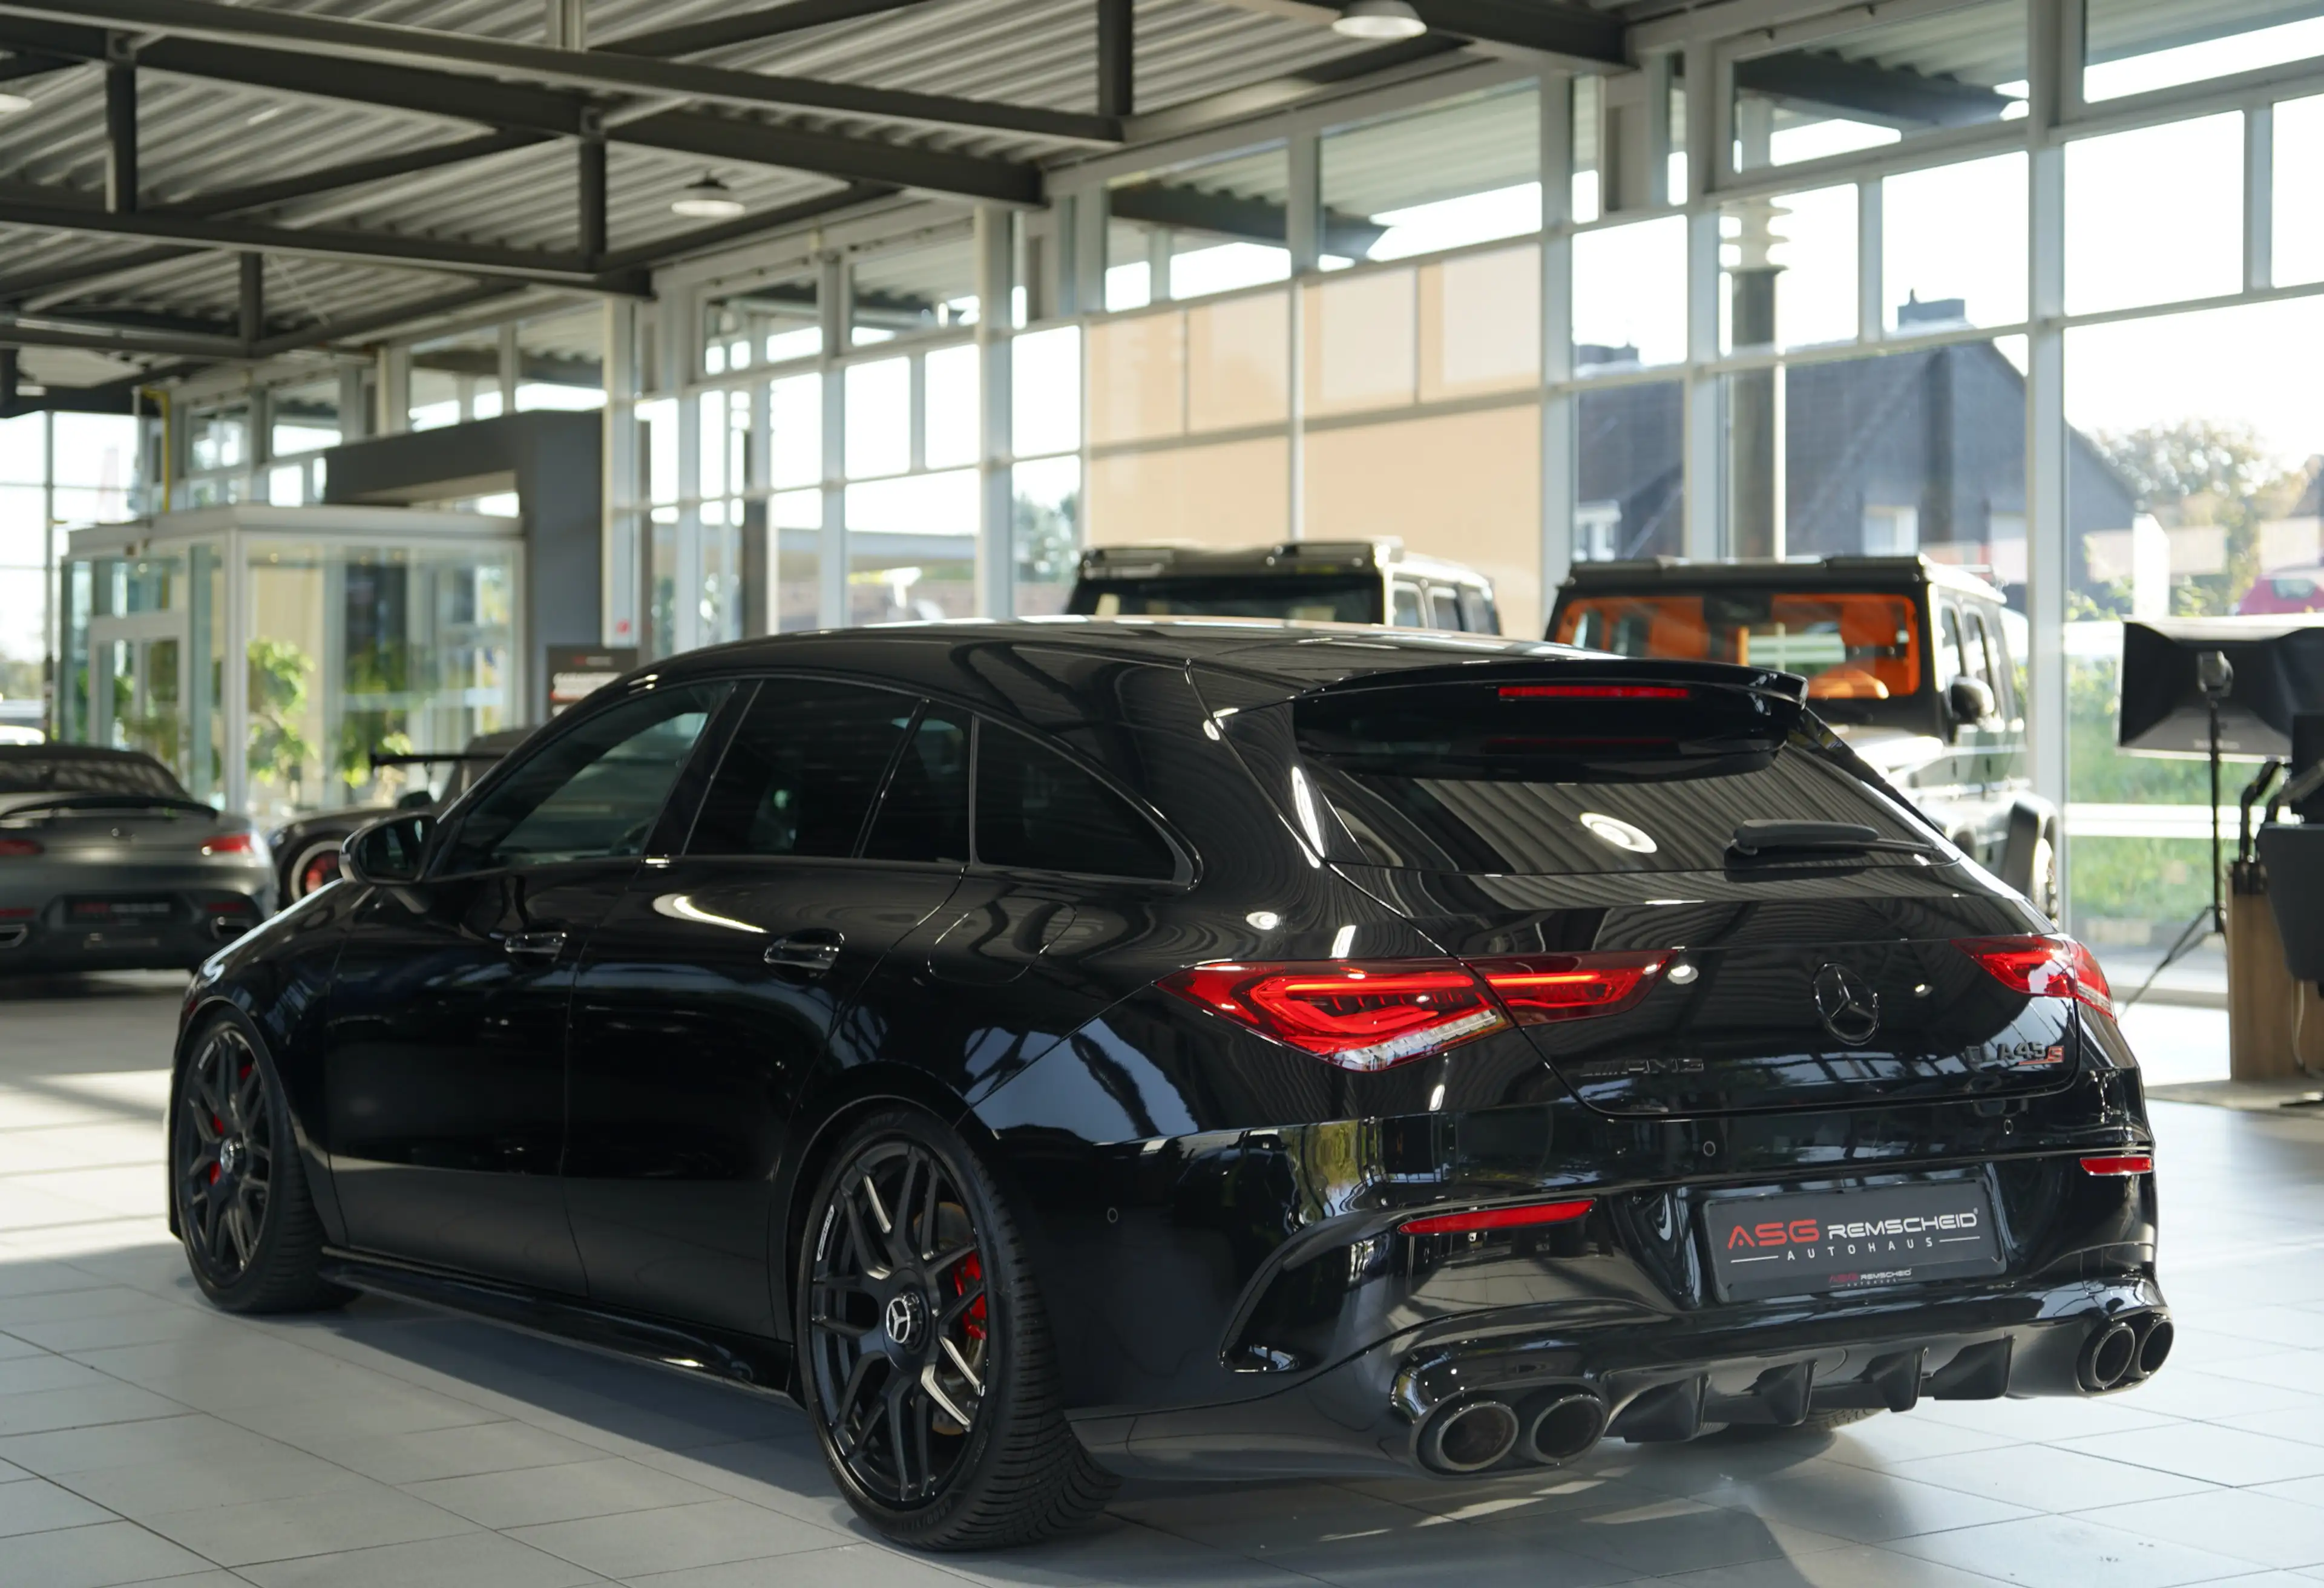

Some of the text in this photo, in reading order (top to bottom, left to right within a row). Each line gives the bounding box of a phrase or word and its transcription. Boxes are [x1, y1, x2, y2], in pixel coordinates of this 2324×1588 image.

[1727, 1212, 1977, 1250] ASG REMSCHEID
[1787, 1237, 1932, 1261] AUTOHAUS
